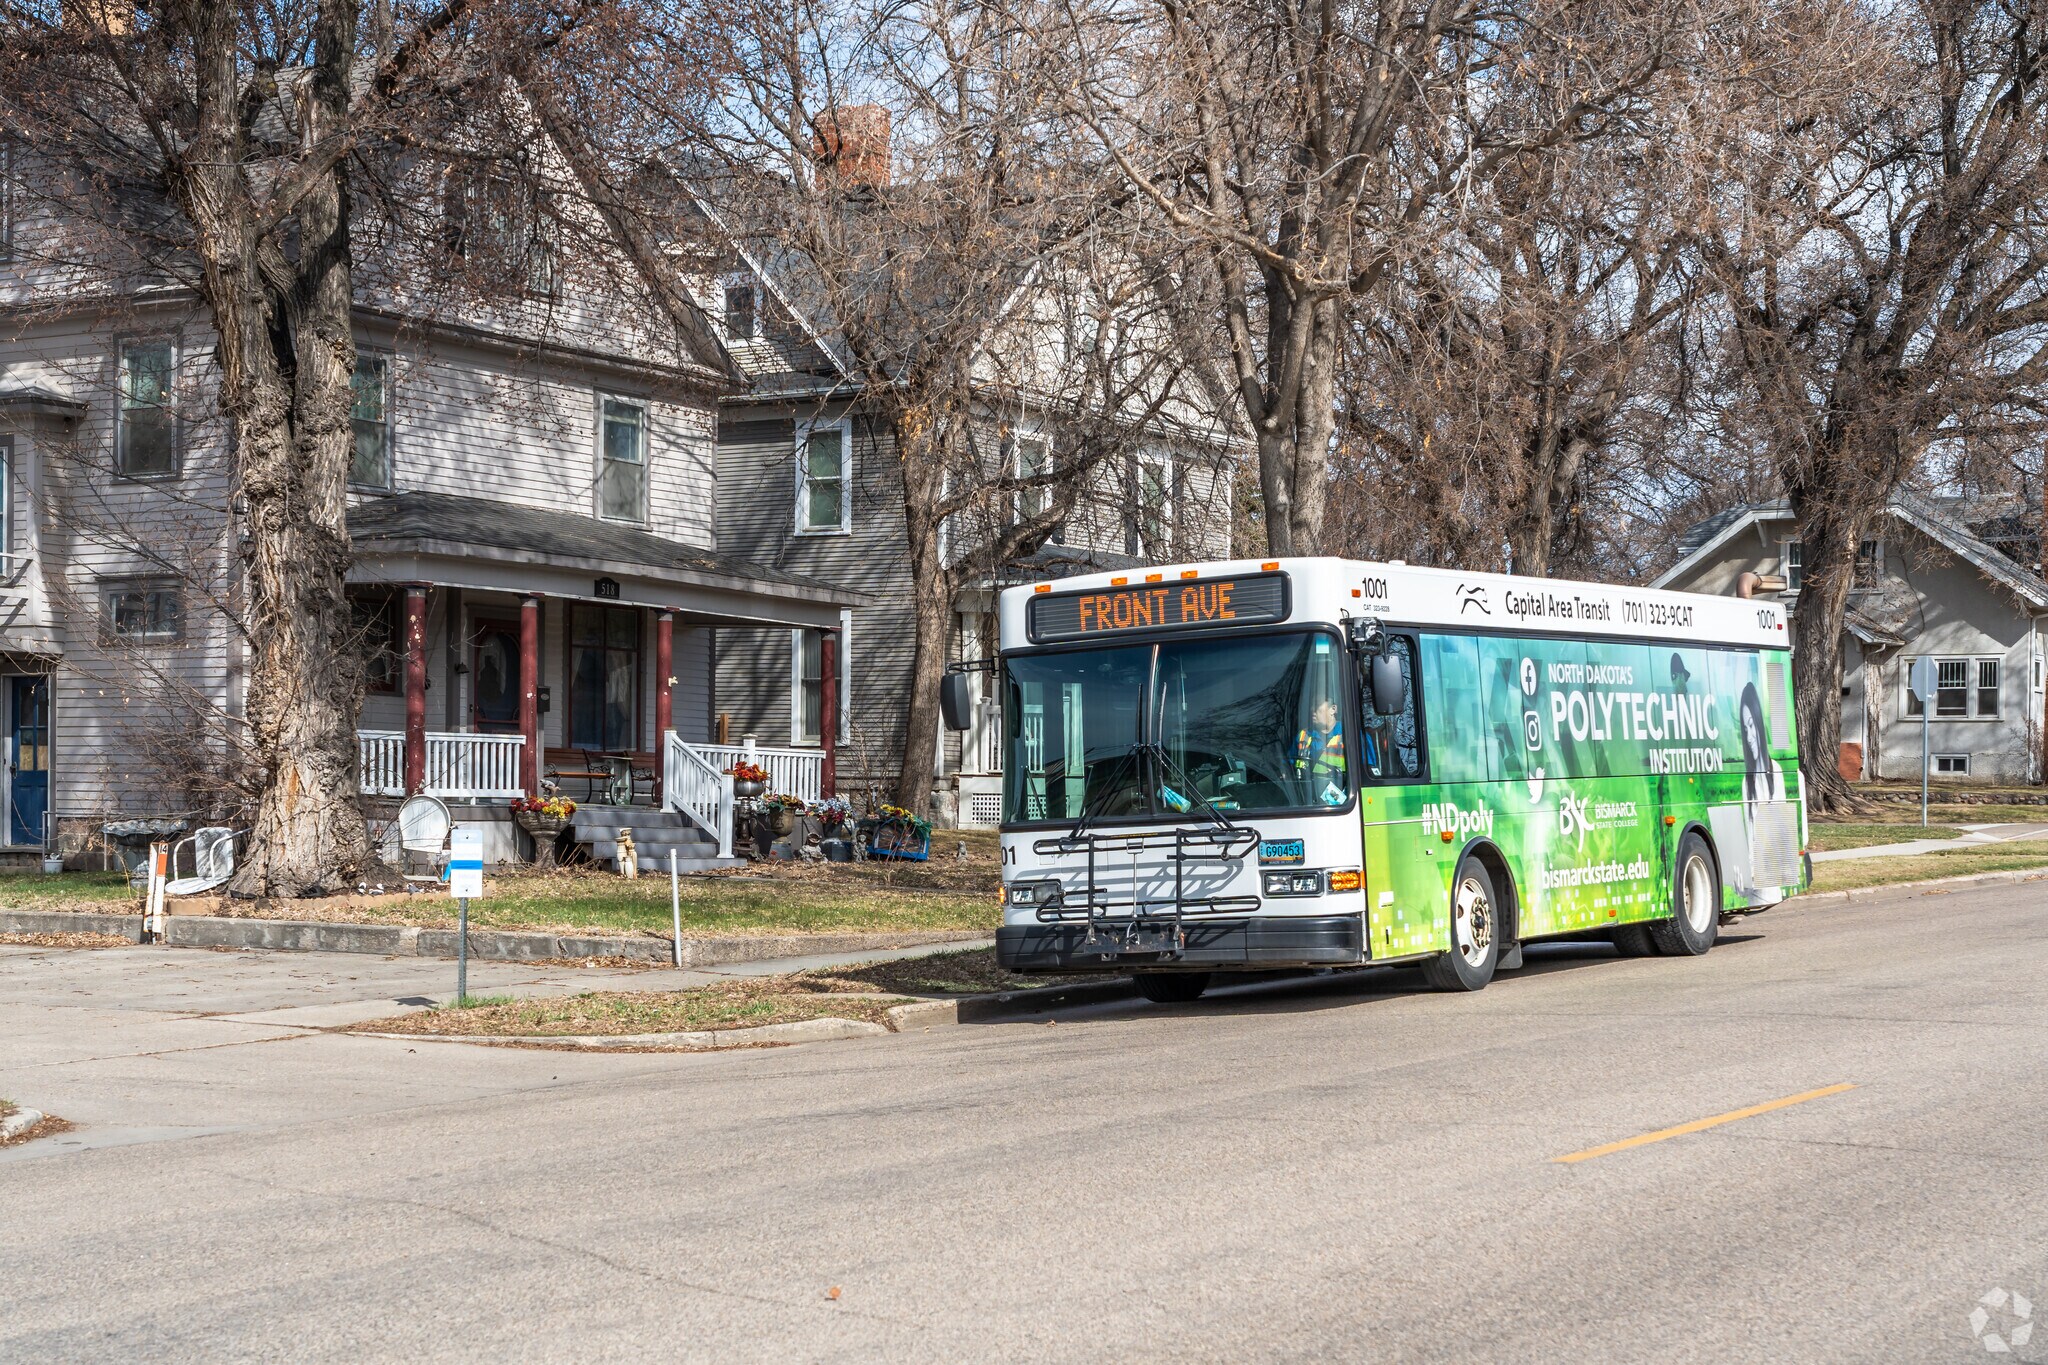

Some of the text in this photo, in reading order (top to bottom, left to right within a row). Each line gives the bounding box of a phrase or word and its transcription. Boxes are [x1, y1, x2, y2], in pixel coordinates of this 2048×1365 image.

[601, 583, 615, 596] 518
[1362, 577, 1388, 599] 1001
[1079, 583, 1235, 632] FRONT AVE
[1505, 590, 1695, 628] Capital Area Transit (701) 323-9CAT
[1756, 610, 1776, 630] 1001
[1548, 663, 1633, 685] NORTH DAKOTA'S
[1551, 690, 1719, 741] POLYTECHNIC
[1650, 747, 1723, 774] INSTITUTION
[1421, 799, 1493, 842] #NDpoly
[1594, 801, 1637, 819] BISMARCK
[1596, 819, 1638, 829] STATE COLLEGE
[1266, 846, 1300, 857] G90453
[1541, 853, 1650, 889] bismarckstate.edu
